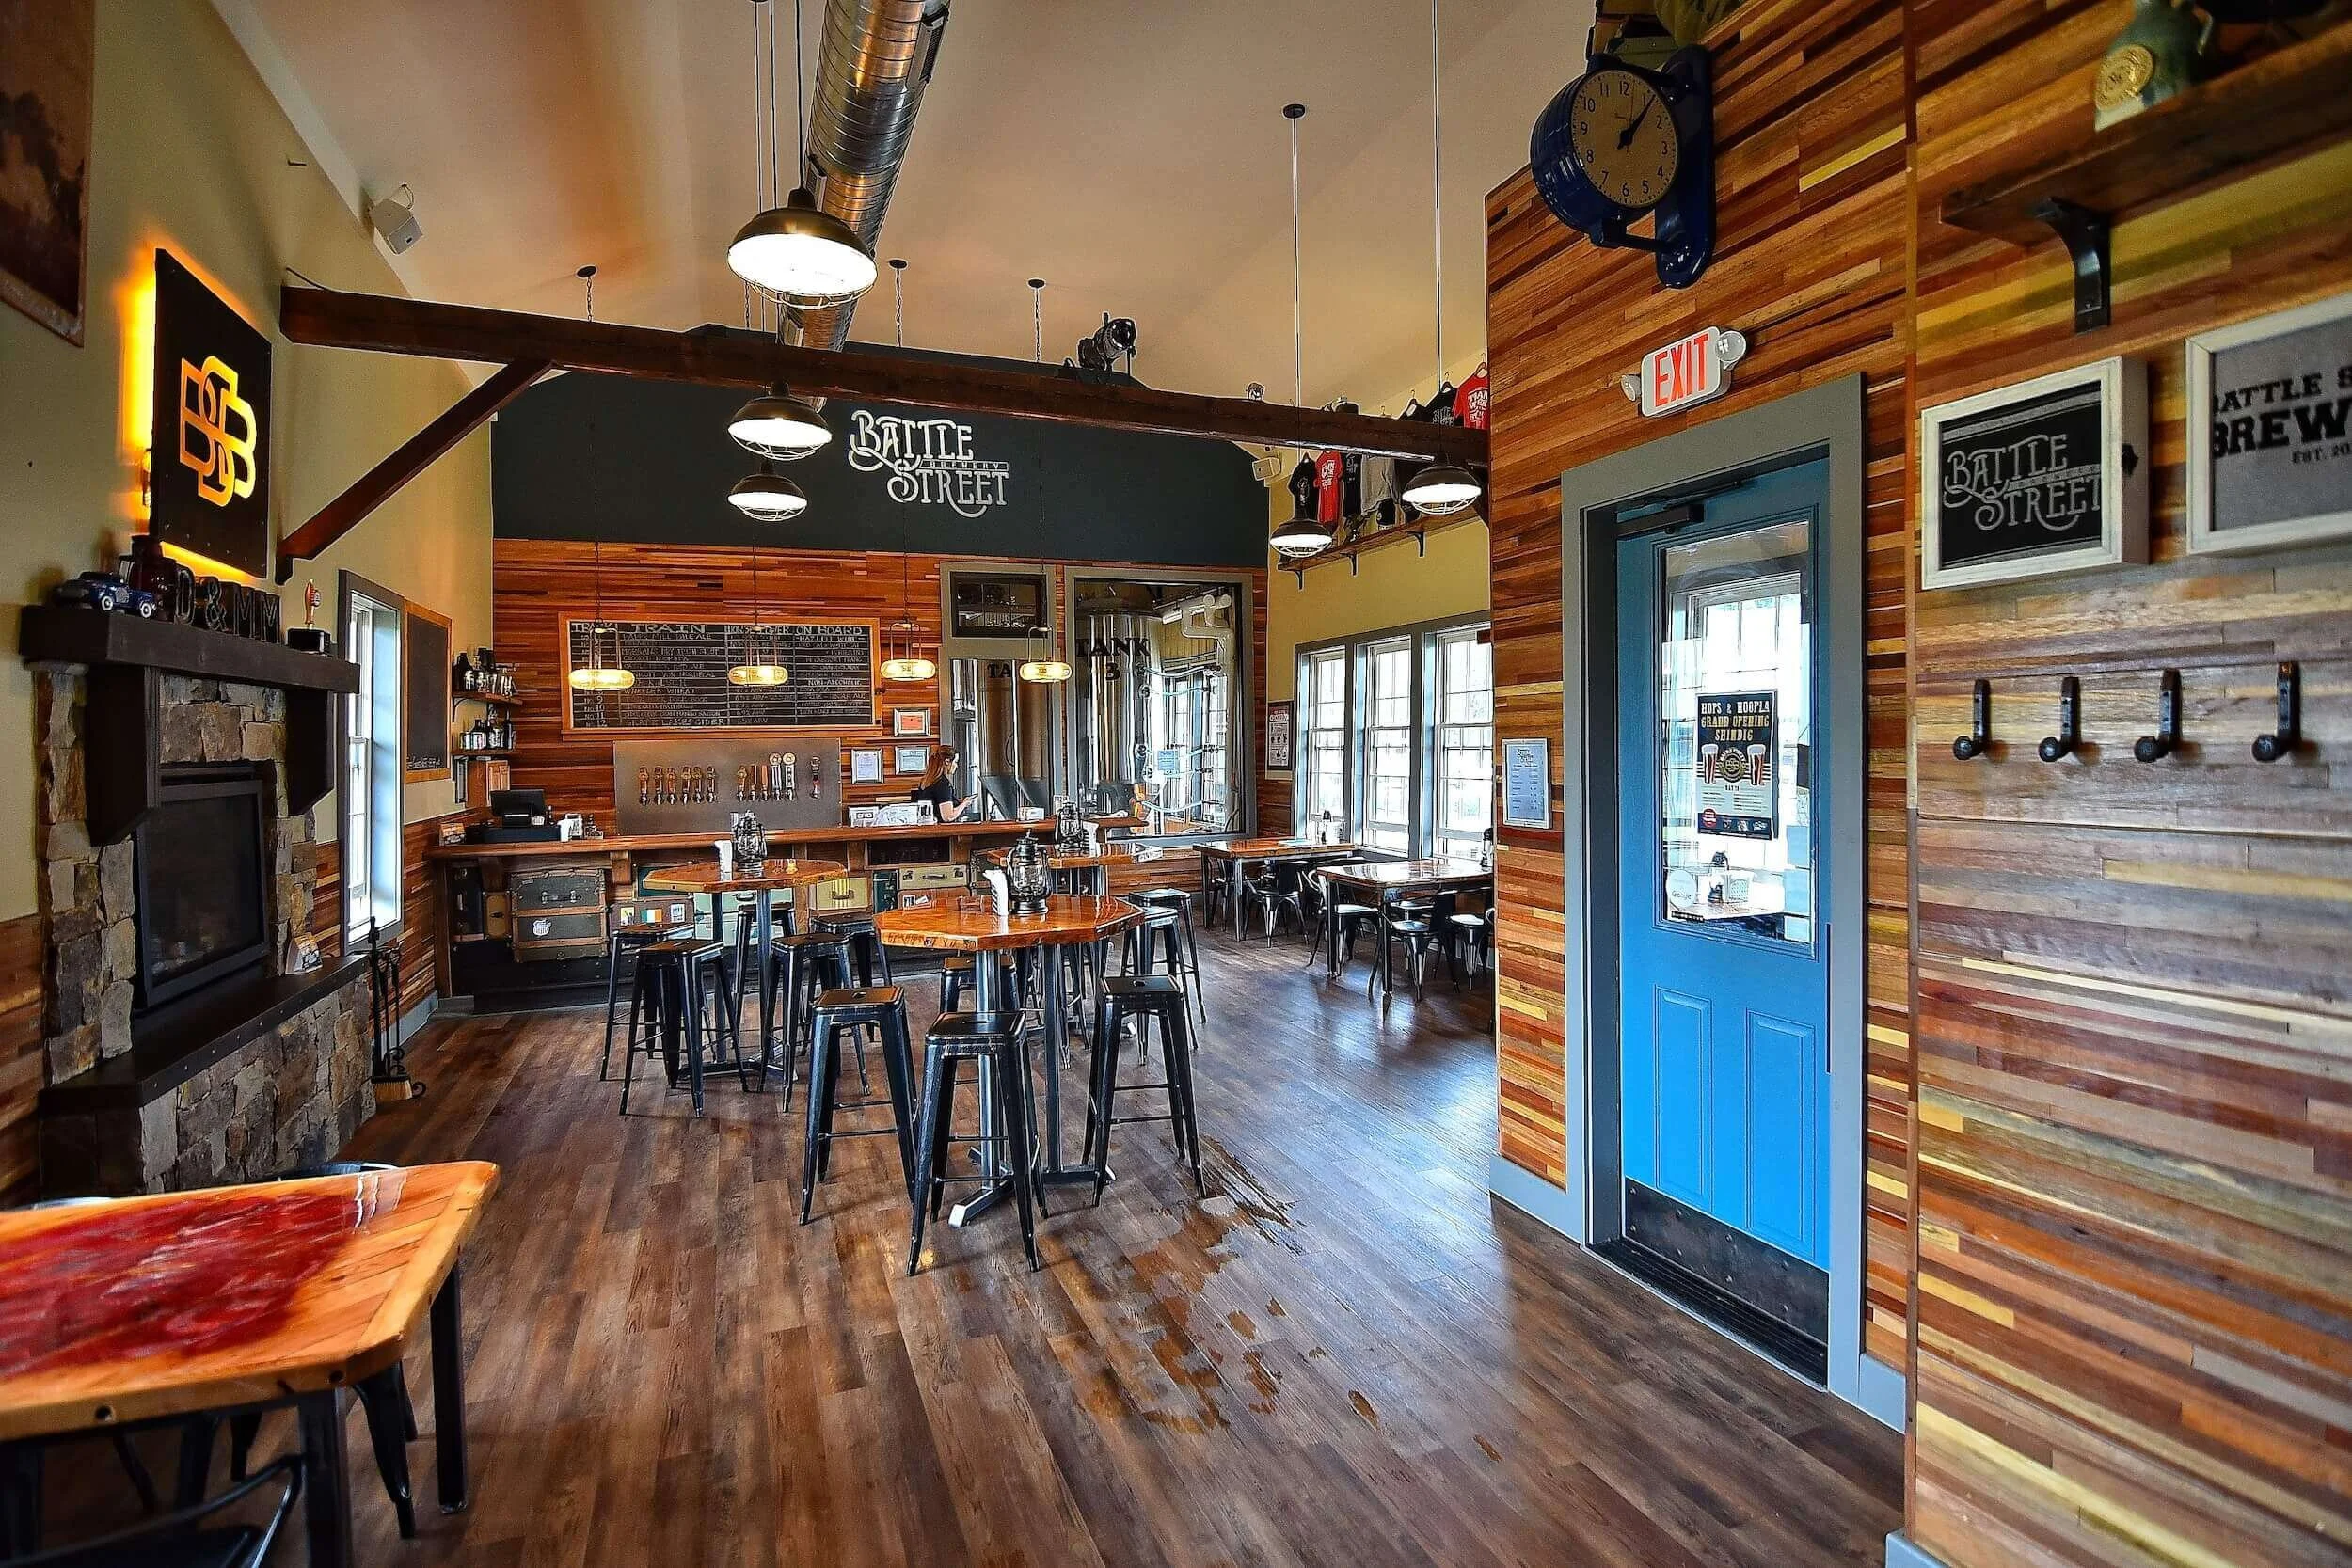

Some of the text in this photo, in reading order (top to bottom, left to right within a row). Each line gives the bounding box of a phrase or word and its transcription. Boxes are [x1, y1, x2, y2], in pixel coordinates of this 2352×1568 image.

[1600, 83, 1609, 98] 11
[1620, 81, 1630, 96] 12
[1582, 97, 1596, 112] 10
[1643, 94, 1646, 106] 1
[1581, 121, 1588, 135] 9
[1656, 115, 1662, 129] 2
[1661, 141, 1668, 155] 3
[1586, 149, 1594, 163] 8
[1601, 170, 1609, 185] 7
[1657, 165, 1664, 179] 4
[1622, 182, 1629, 197] 6
[1642, 180, 1649, 194] 5
[1655, 333, 1709, 407] EXIT
[2214, 372, 2322, 414] ATTLE
[849, 410, 974, 471] BATTLE
[1943, 434, 2068, 508] BATTLE
[887, 458, 1009, 518] STREET
[1975, 474, 2101, 531] STREET
[631, 624, 706, 634] TRAIN
[796, 626, 863, 635] ON BOARD
[1701, 702, 1723, 715] HOPS
[1737, 700, 1770, 714] HOOPLA
[695, 718, 724, 726] CIDER
[1701, 715, 1770, 728] GRAND OPENING
[1715, 729, 1754, 741] SHINDIG
